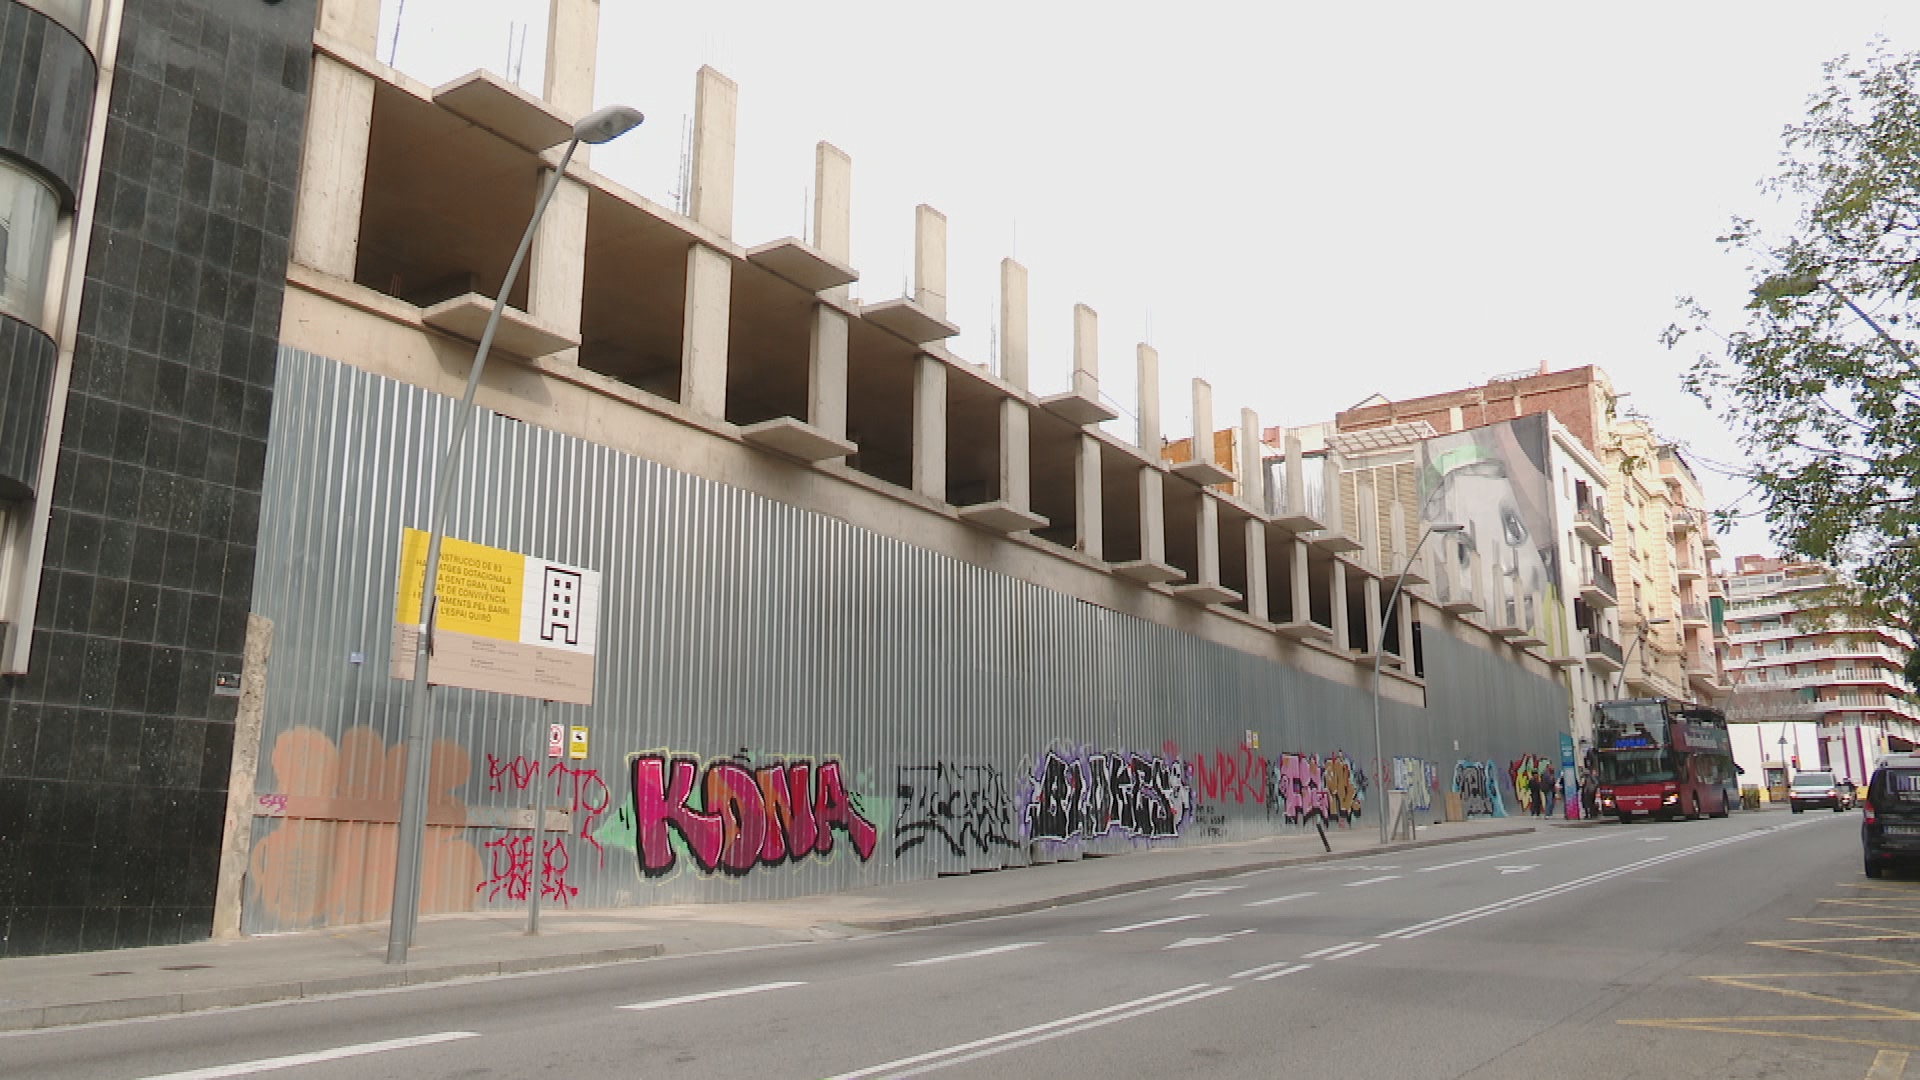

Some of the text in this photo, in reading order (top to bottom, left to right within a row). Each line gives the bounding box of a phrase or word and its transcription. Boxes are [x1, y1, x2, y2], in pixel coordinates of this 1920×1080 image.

[463, 568, 512, 585] DOTACIONALS
[444, 575, 465, 585] GENT
[490, 583, 505, 594] UNA
[446, 586, 456, 595] DE
[472, 601, 487, 611] PEL
